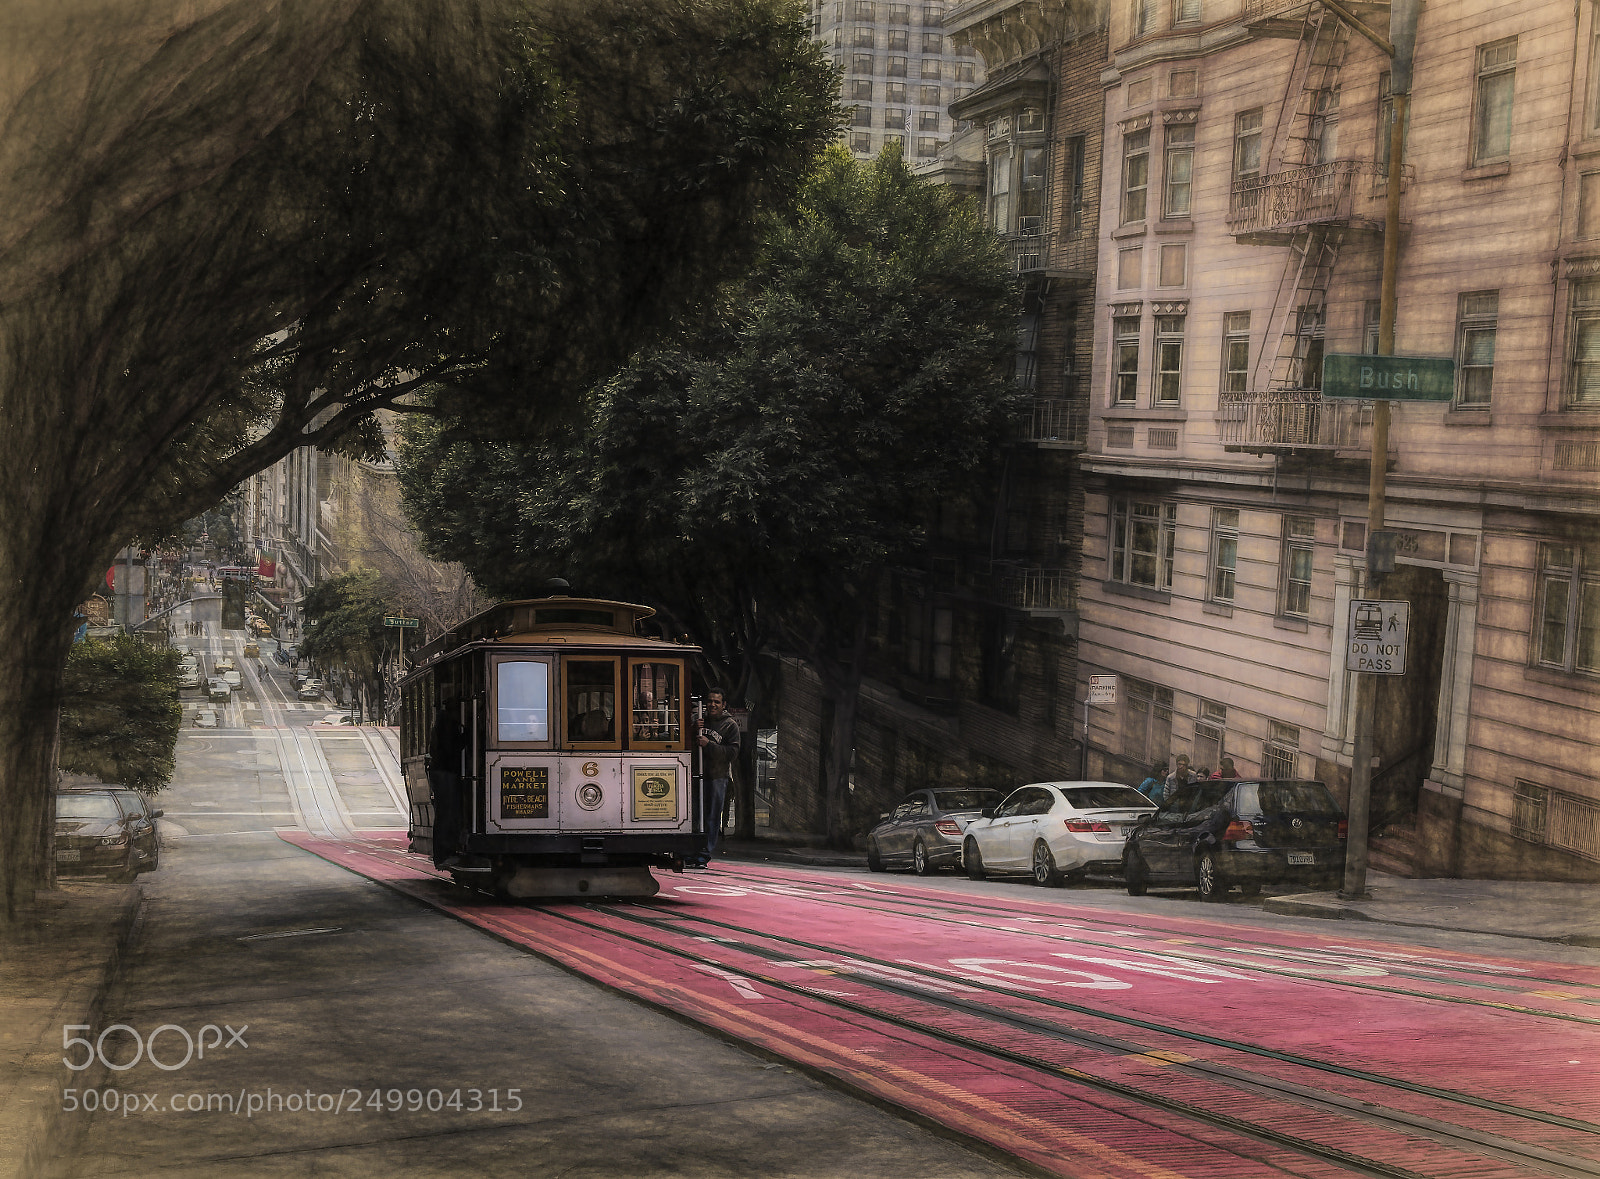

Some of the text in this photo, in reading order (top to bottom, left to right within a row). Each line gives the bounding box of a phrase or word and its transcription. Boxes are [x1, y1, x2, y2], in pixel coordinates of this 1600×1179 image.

[1359, 366, 1418, 390] Bush
[389, 618, 414, 626] Sutter
[1352, 642, 1401, 656] DO NOT
[1358, 658, 1392, 671] PASS
[503, 770, 547, 778] POWELL
[581, 761, 599, 777] 6
